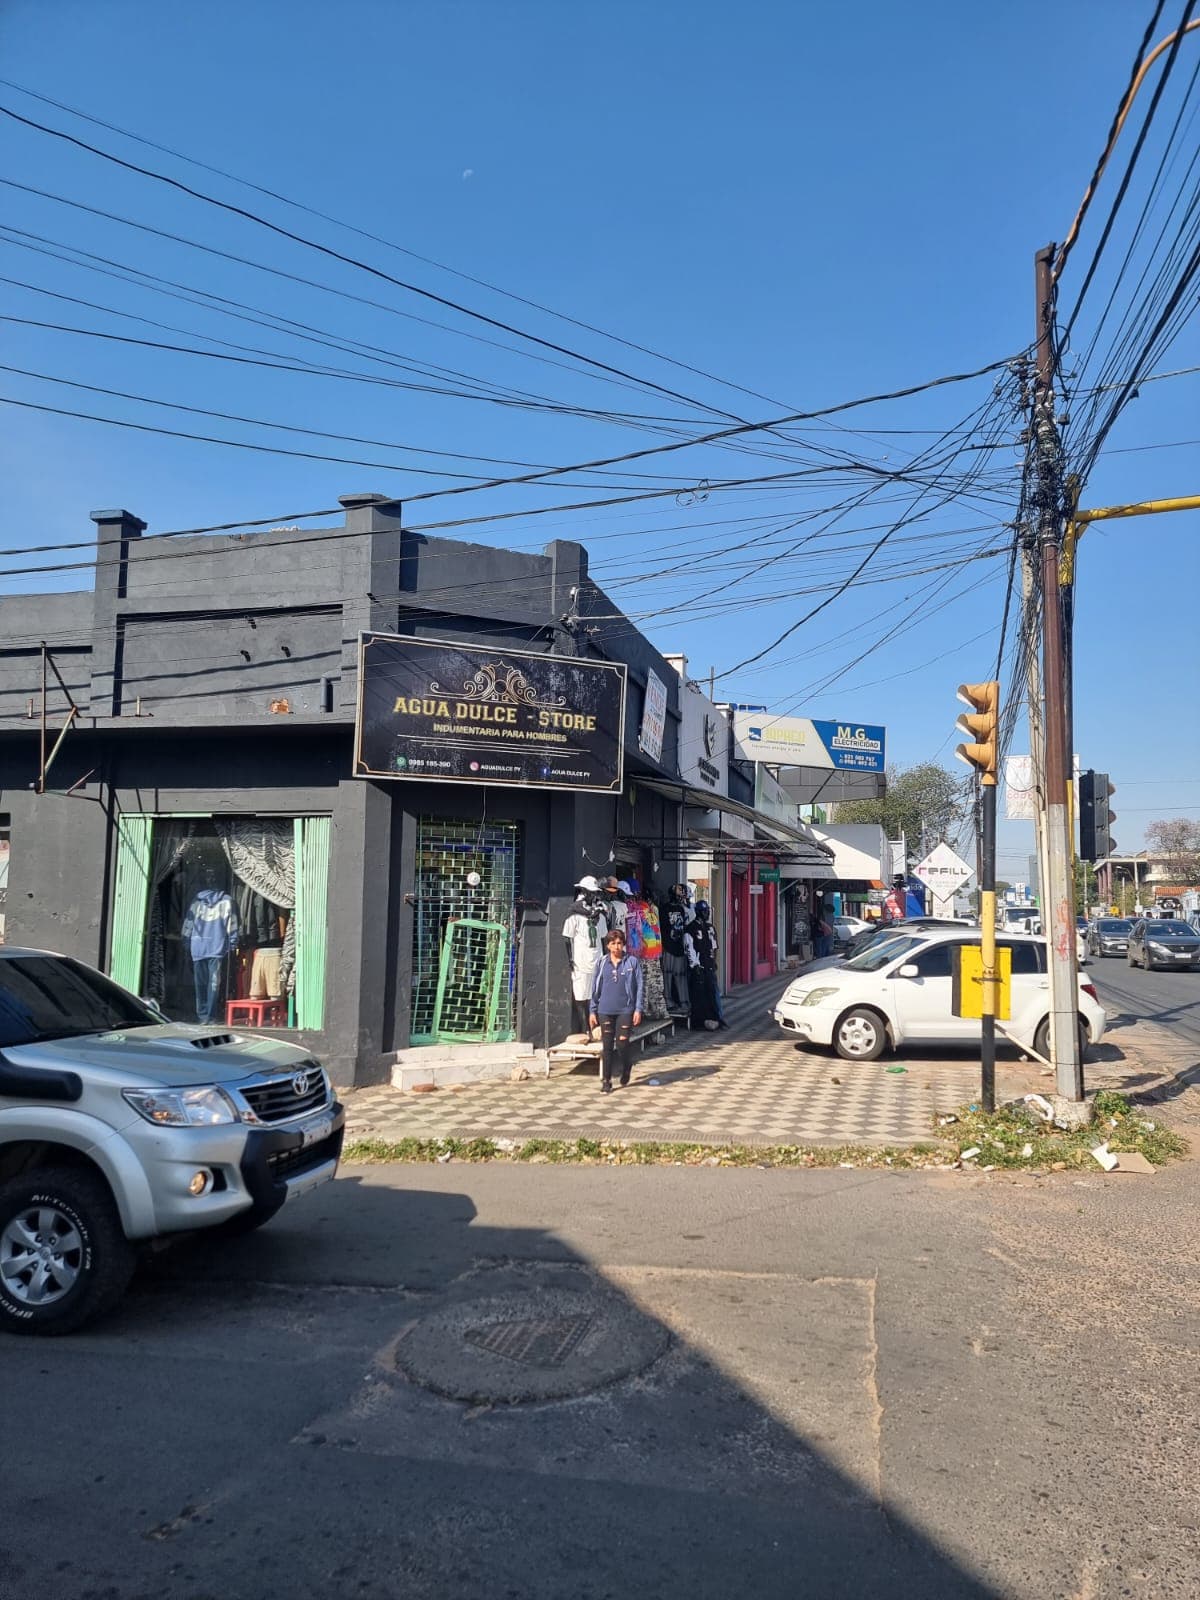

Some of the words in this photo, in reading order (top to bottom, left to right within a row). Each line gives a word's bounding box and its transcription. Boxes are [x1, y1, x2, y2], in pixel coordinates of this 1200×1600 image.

[393, 697, 450, 718] AGUA
[456, 703, 518, 724] DULCE
[538, 711, 597, 731] STORE
[433, 723, 501, 737] INDUMENTARIA
[502, 729, 525, 740] PARA
[526, 732, 567, 743] HOMBRES
[834, 738, 879, 749] ELECTRICIDAD
